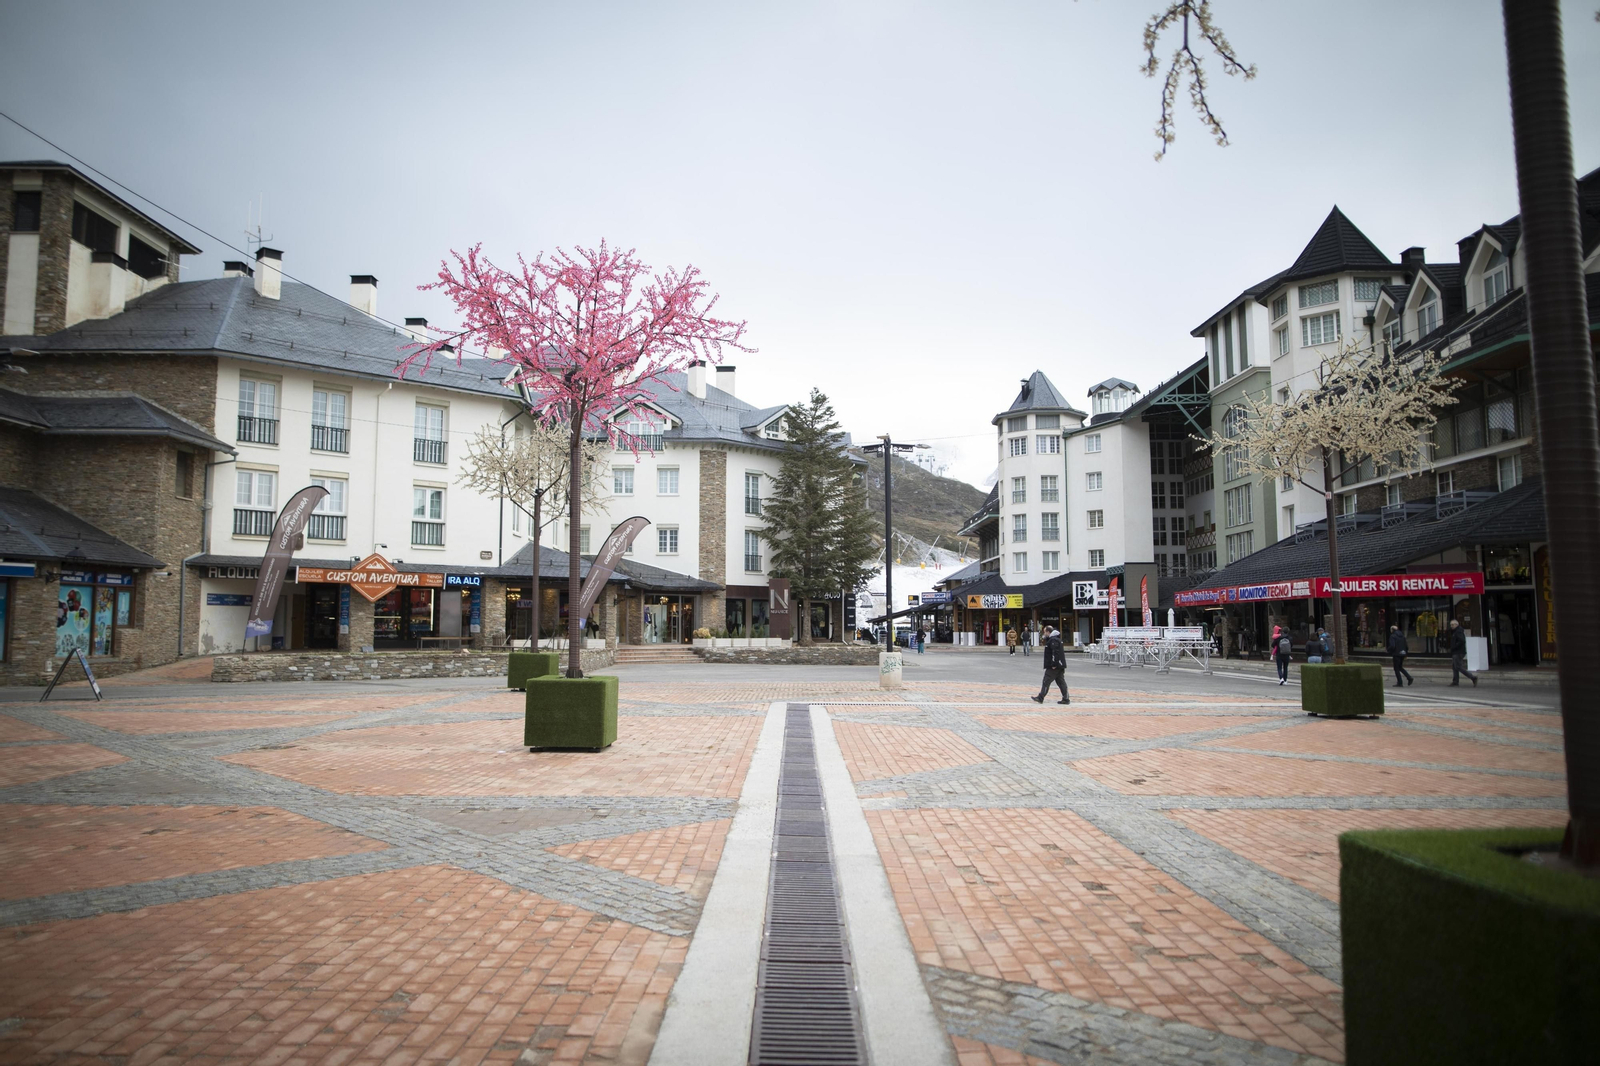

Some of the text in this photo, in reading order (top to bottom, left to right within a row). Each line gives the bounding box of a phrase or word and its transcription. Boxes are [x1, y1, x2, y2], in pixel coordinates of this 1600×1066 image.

[280, 497, 309, 550] CUSTOM AVENTURA
[604, 525, 633, 564] CUSTOM AVENTURA
[327, 571, 419, 585] CUSTOM AVENTURA
[463, 577, 480, 585] ALQ
[1323, 580, 1377, 592] AQUILER
[1379, 580, 1399, 591] SKI
[1402, 578, 1449, 590] RENTAL
[770, 589, 788, 609] N
[1240, 583, 1289, 600] MONITORTECNO
[1075, 597, 1095, 606] SNOW
